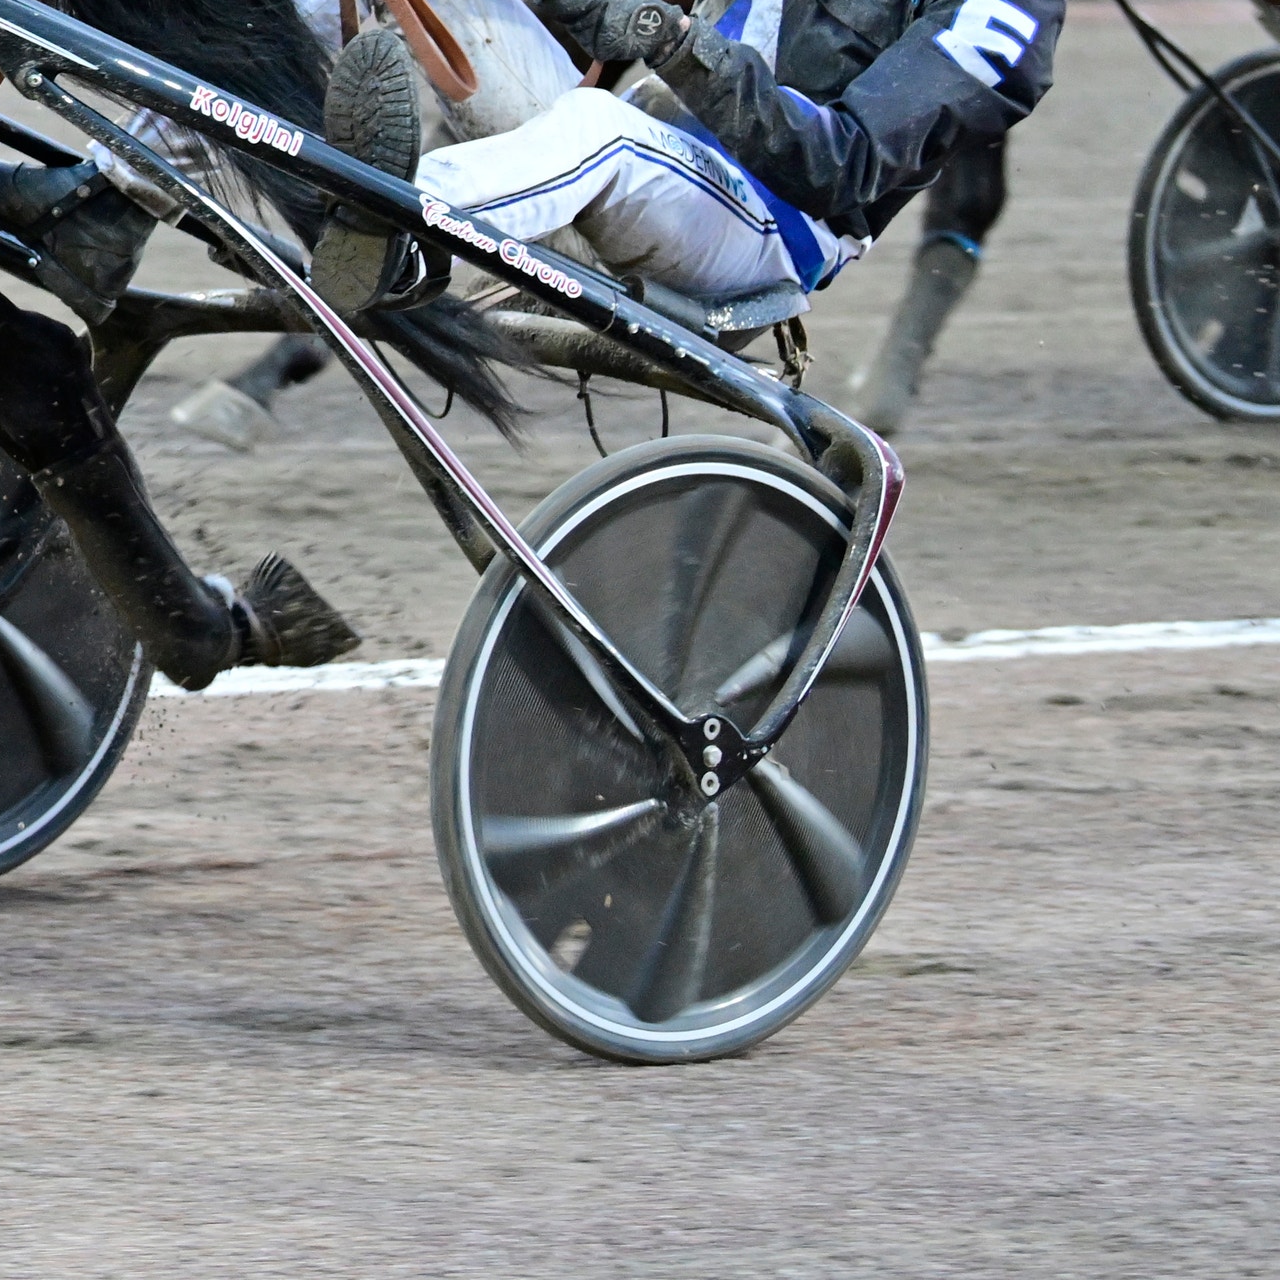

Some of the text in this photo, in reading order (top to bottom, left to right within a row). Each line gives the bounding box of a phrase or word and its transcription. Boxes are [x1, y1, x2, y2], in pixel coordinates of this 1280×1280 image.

[189, 85, 305, 157] Kolgjini
[419, 192, 583, 299] Custom Chrono
